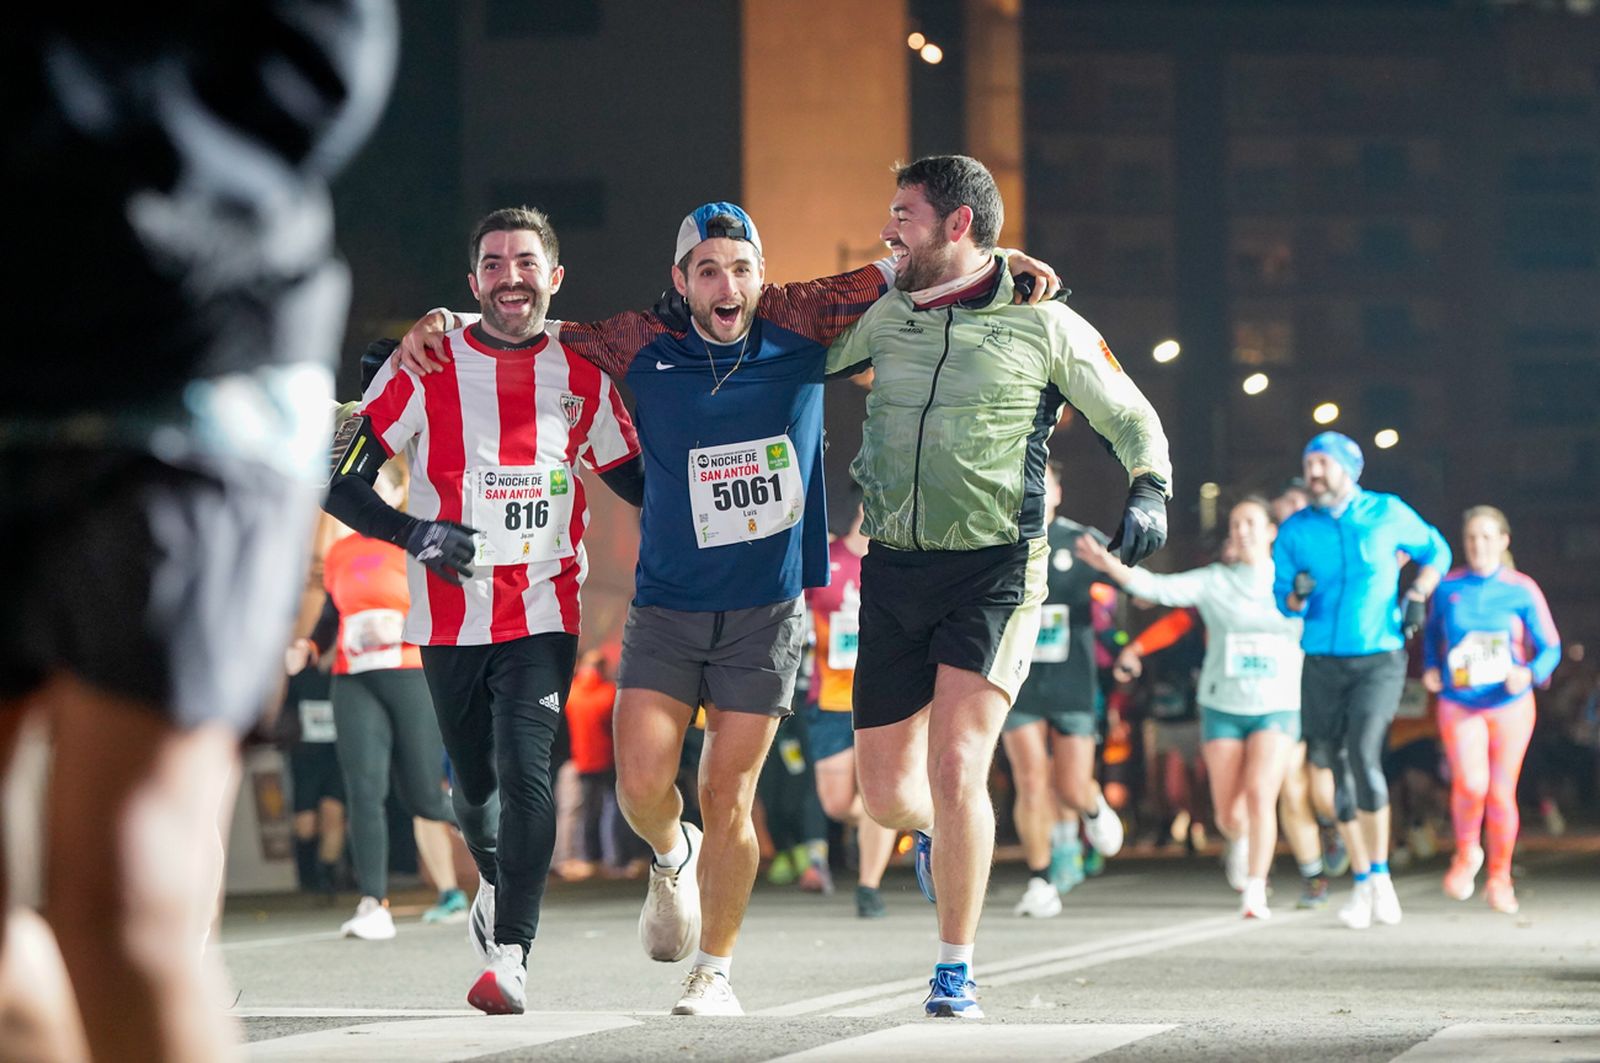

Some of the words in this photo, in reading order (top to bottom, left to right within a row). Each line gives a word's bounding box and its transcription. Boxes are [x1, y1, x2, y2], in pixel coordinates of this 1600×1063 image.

[711, 454, 743, 468] NOCHE
[745, 452, 757, 463] DE
[700, 470, 721, 482] SAN
[724, 462, 759, 479] ANTÓN
[498, 477, 530, 487] NOCHE
[531, 476, 543, 486] DE
[485, 489, 507, 500] SAN
[509, 486, 543, 499] ANTÓN
[712, 473, 782, 511] 5061
[505, 500, 549, 531] 816
[743, 509, 758, 517] Luis
